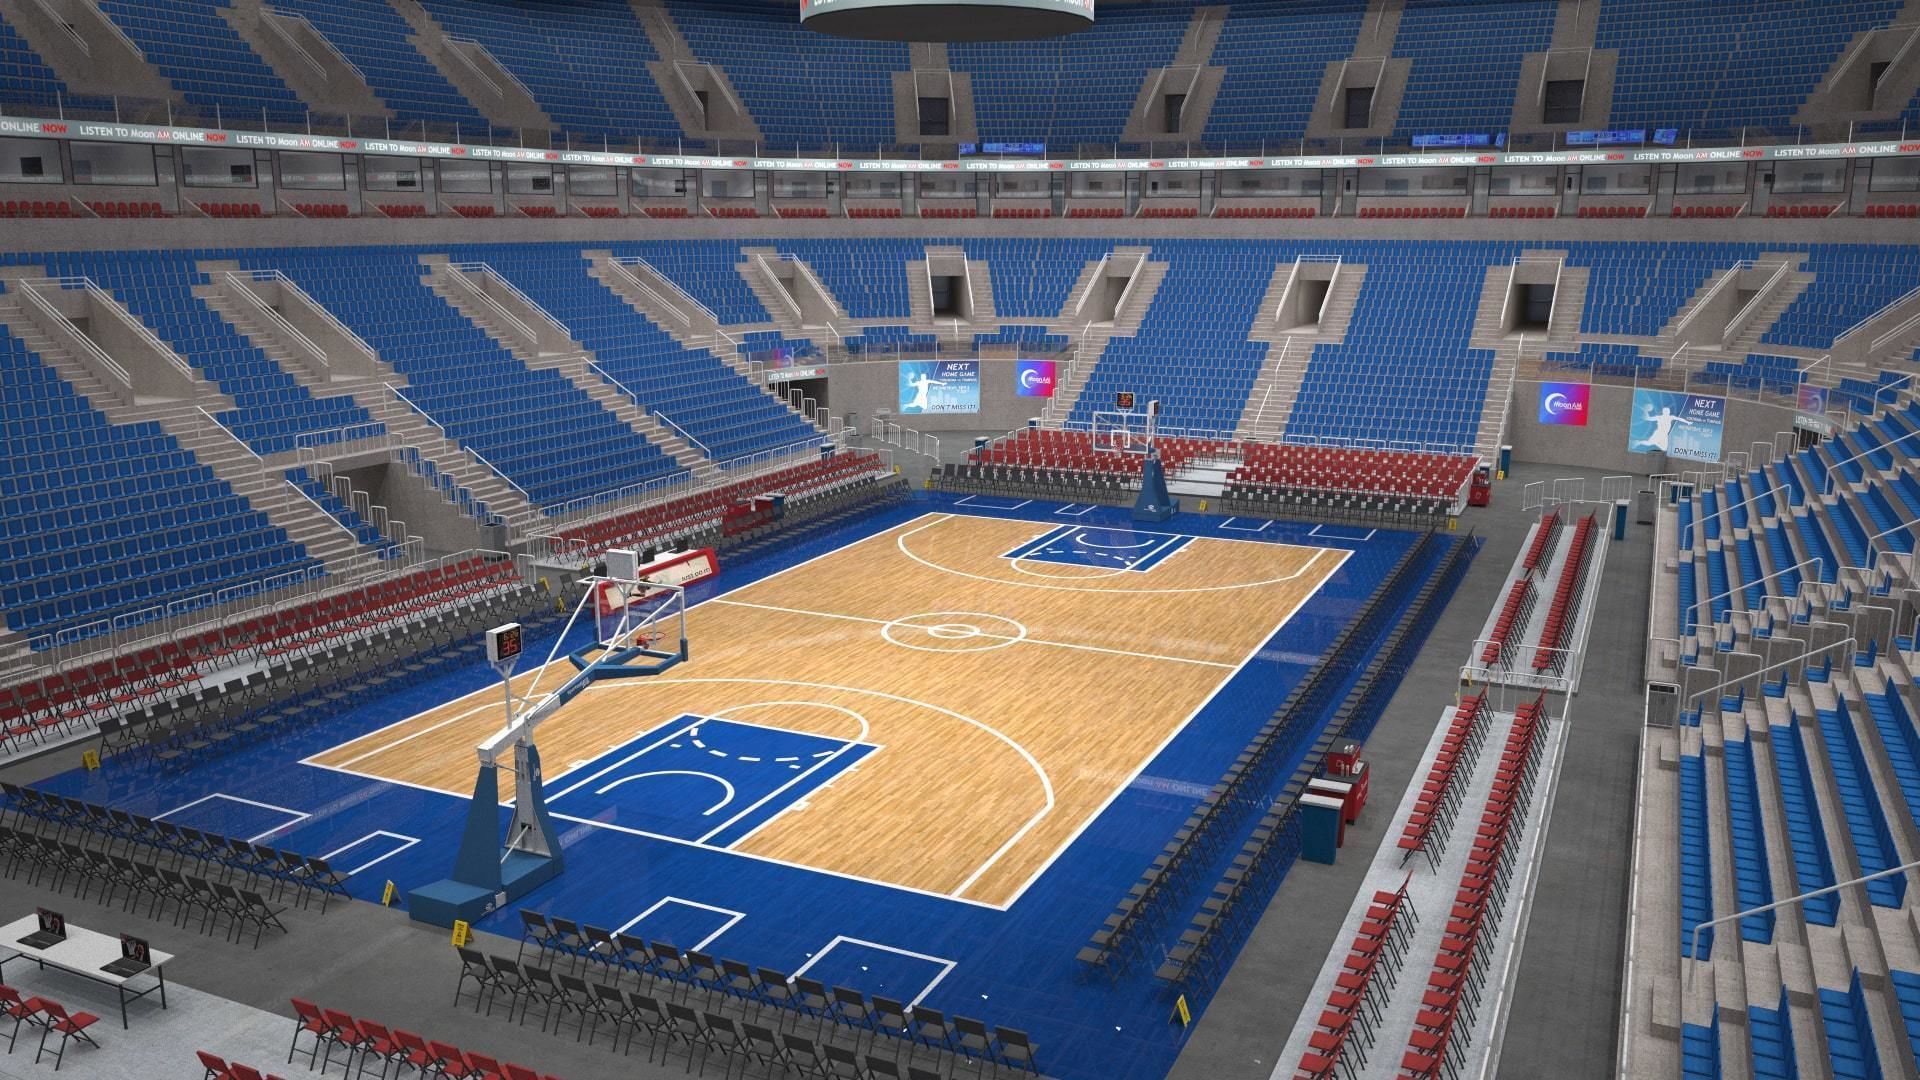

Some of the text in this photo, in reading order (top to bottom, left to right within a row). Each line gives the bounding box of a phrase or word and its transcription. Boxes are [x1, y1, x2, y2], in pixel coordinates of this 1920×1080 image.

[1, 121, 68, 133] ONLINE NOW
[80, 126, 226, 141] LISTEN TO Moon AM ONLINE NOW
[237, 135, 264, 144] LISTEN
[278, 137, 298, 146] Moon
[312, 139, 338, 148] ONLINE
[365, 142, 388, 150] LISTEN
[400, 144, 416, 152] Moon
[1859, 145, 1897, 153] ONLINE
[1694, 399, 1716, 408] NEXT
[1674, 447, 1693, 456] DON'T
